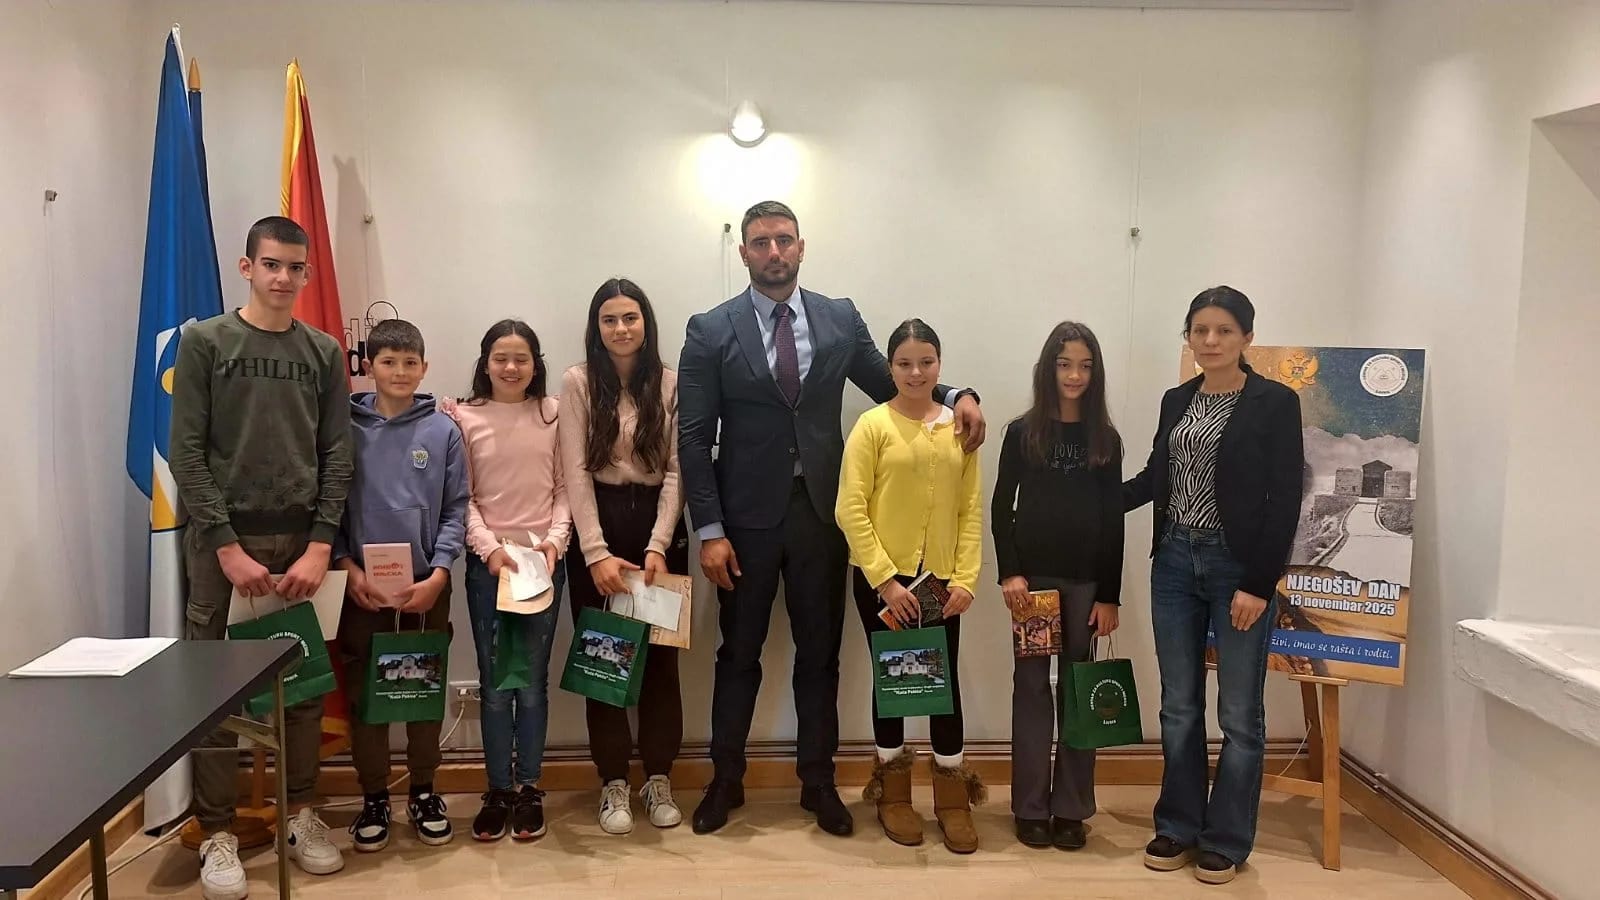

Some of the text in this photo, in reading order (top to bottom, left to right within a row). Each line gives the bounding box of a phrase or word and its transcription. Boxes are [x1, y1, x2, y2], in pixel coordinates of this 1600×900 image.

[1054, 443, 1080, 460] LOVE
[1287, 574, 1400, 600] NJEGOŠEV DAN
[1289, 594, 1396, 616] 13 novembar 2025
[1293, 639, 1316, 651] imao
[1318, 643, 1328, 652] se
[1330, 643, 1355, 656] rašta
[1364, 647, 1394, 660] roditi.
